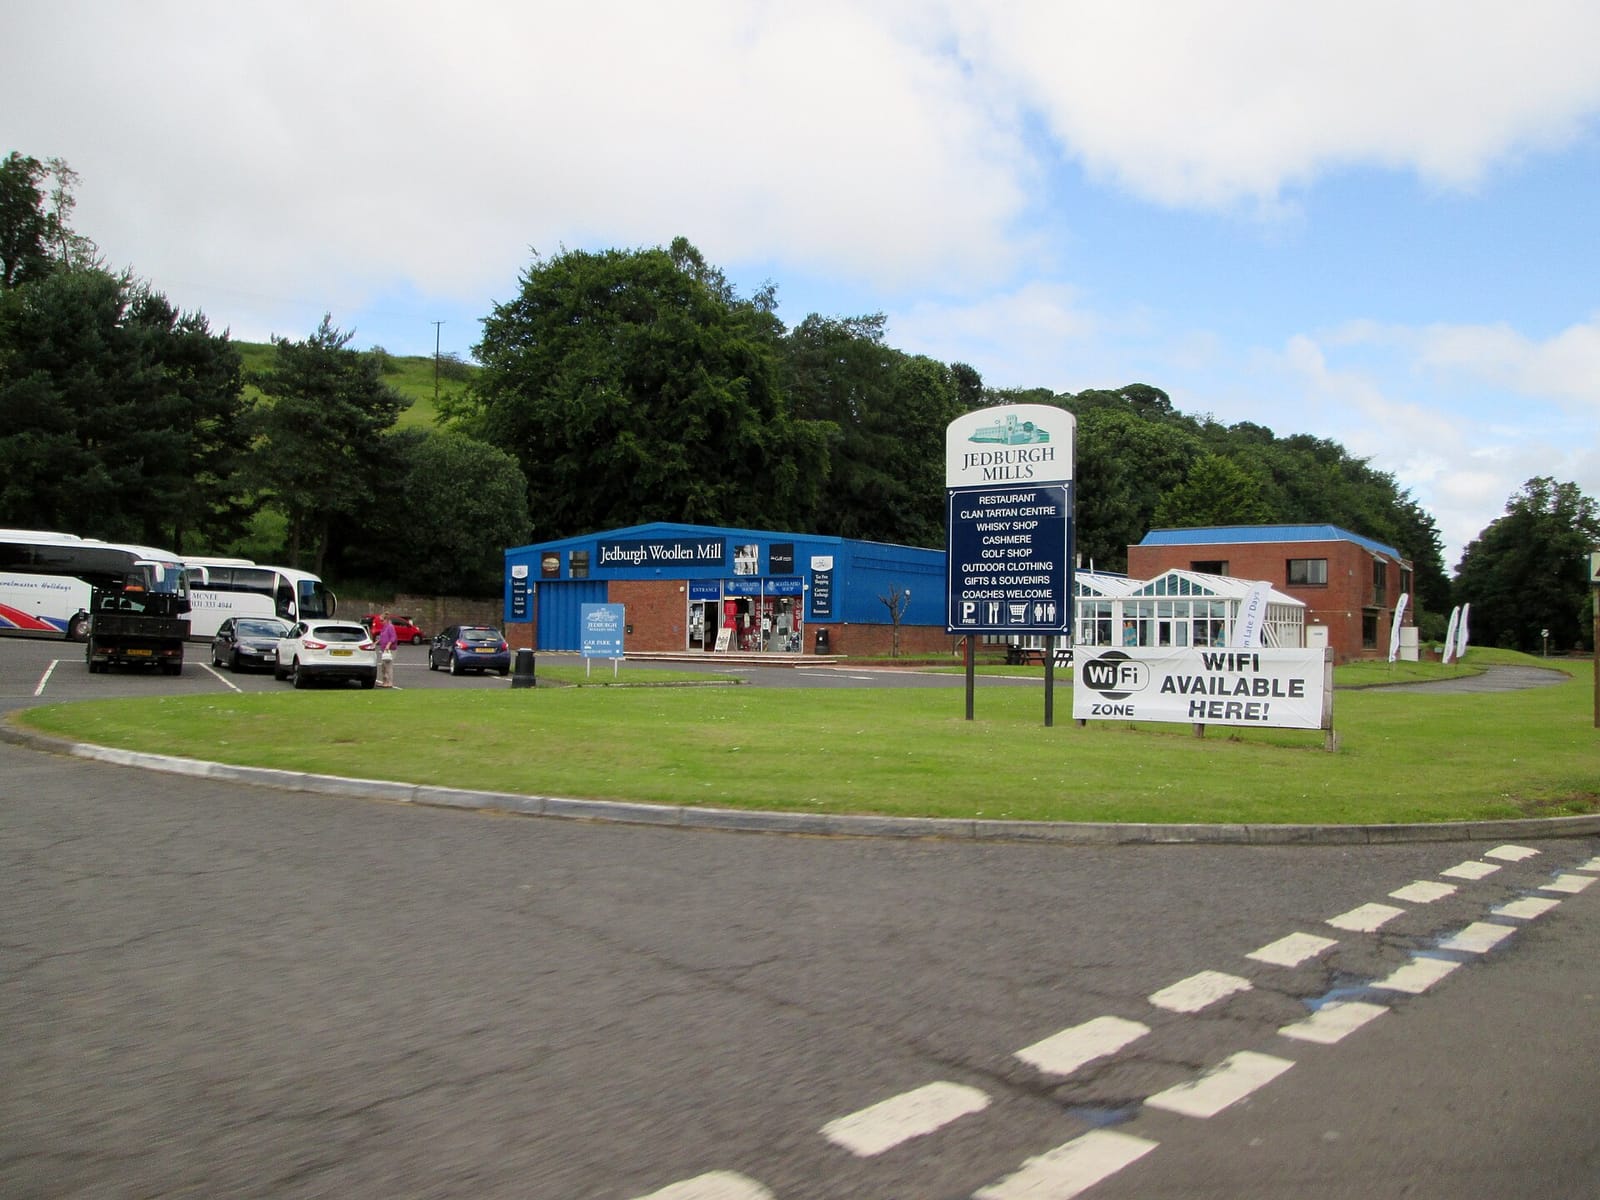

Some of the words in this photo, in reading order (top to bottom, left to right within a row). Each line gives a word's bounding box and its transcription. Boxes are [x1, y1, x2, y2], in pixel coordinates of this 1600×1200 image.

[962, 447, 1055, 470] JEDBURGH
[983, 464, 1034, 481] MILLS
[979, 493, 1036, 505] RESTAURANT
[960, 510, 984, 519] CLAN
[985, 508, 1018, 518] TARTAN
[1019, 506, 1056, 516] CENTRE
[976, 522, 1011, 532] WHISKY
[1012, 520, 1038, 530] SHOP
[982, 535, 1032, 545] CASHMERE
[600, 545, 647, 565] Jedburgh
[649, 544, 694, 560] Woollen
[697, 543, 722, 559] Mill
[981, 549, 1006, 559] GOLF
[1007, 548, 1033, 558] SHOP
[962, 563, 1006, 573] OUTDOOR
[1007, 562, 1053, 572] CLOTHING
[964, 576, 990, 586] GIFTS
[991, 576, 997, 586] &
[999, 575, 1050, 586] SOUVENIRS
[962, 590, 1005, 599] COACHES
[1006, 589, 1053, 599] WELCOME
[963, 602, 976, 619] P
[1243, 621, 1254, 638] Late
[1249, 591, 1260, 611] Days
[1202, 652, 1260, 673] WIFI
[1088, 665, 1138, 685] WiFi
[1160, 676, 1305, 698] AVAILABLE
[1092, 704, 1135, 716] ZONE
[1188, 700, 1270, 721] HERE!
